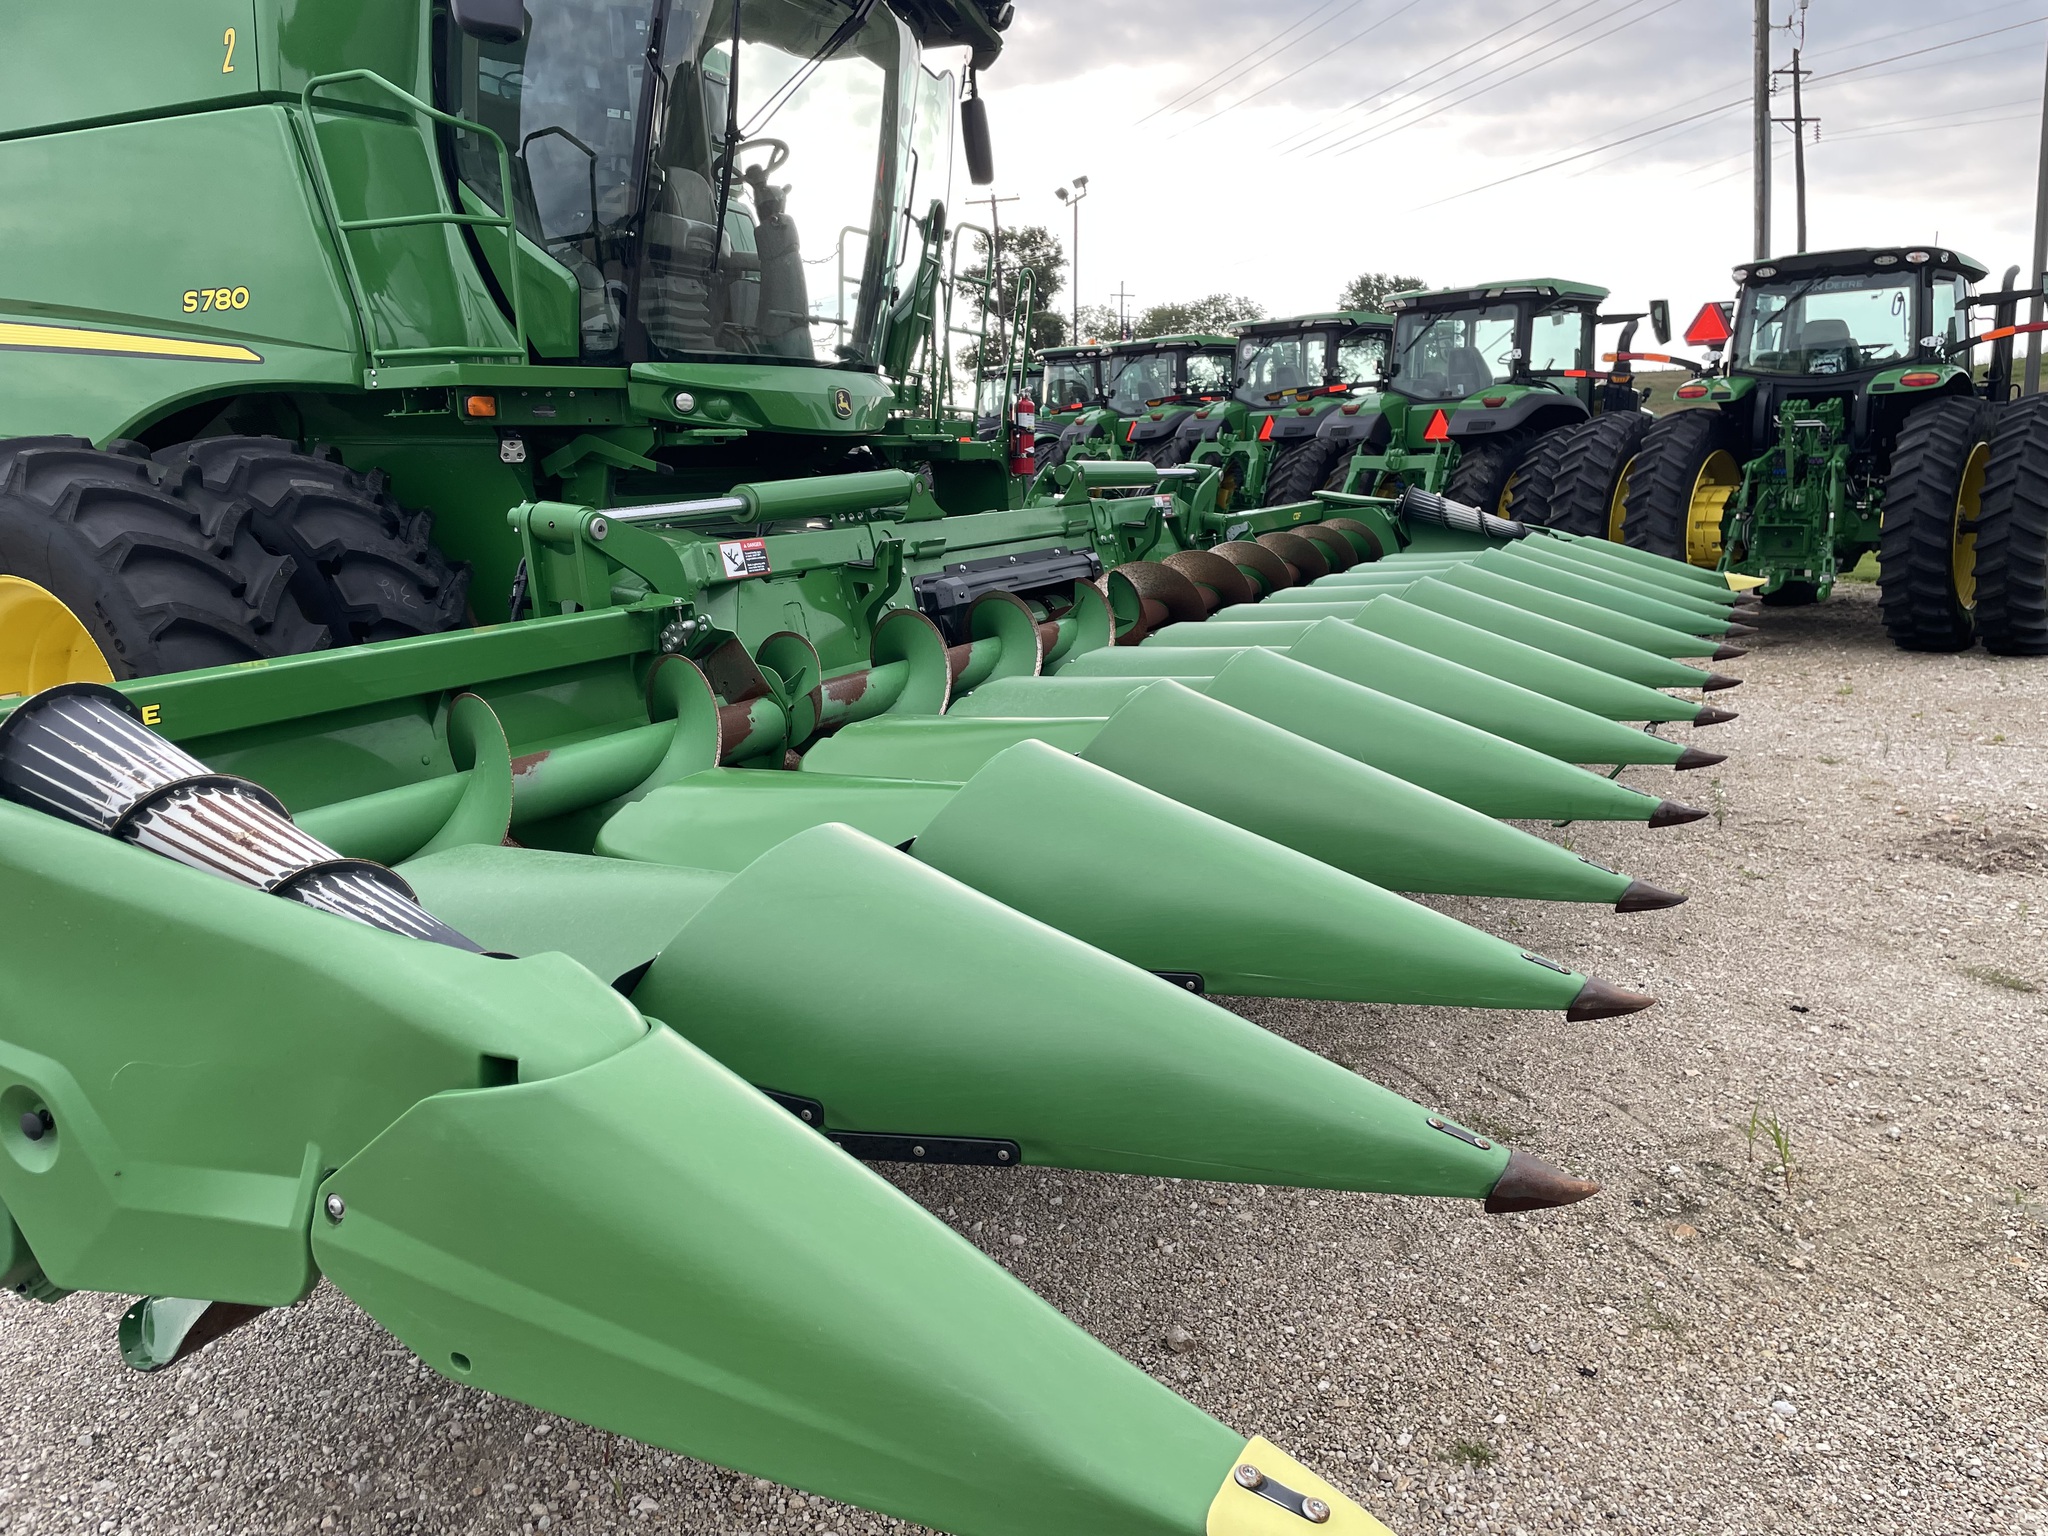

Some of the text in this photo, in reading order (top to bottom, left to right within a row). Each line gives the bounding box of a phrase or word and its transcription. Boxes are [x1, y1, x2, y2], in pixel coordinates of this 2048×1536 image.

[222, 27, 236, 74] 2
[183, 286, 250, 313] S780
[1792, 280, 1864, 294] JN DEERE
